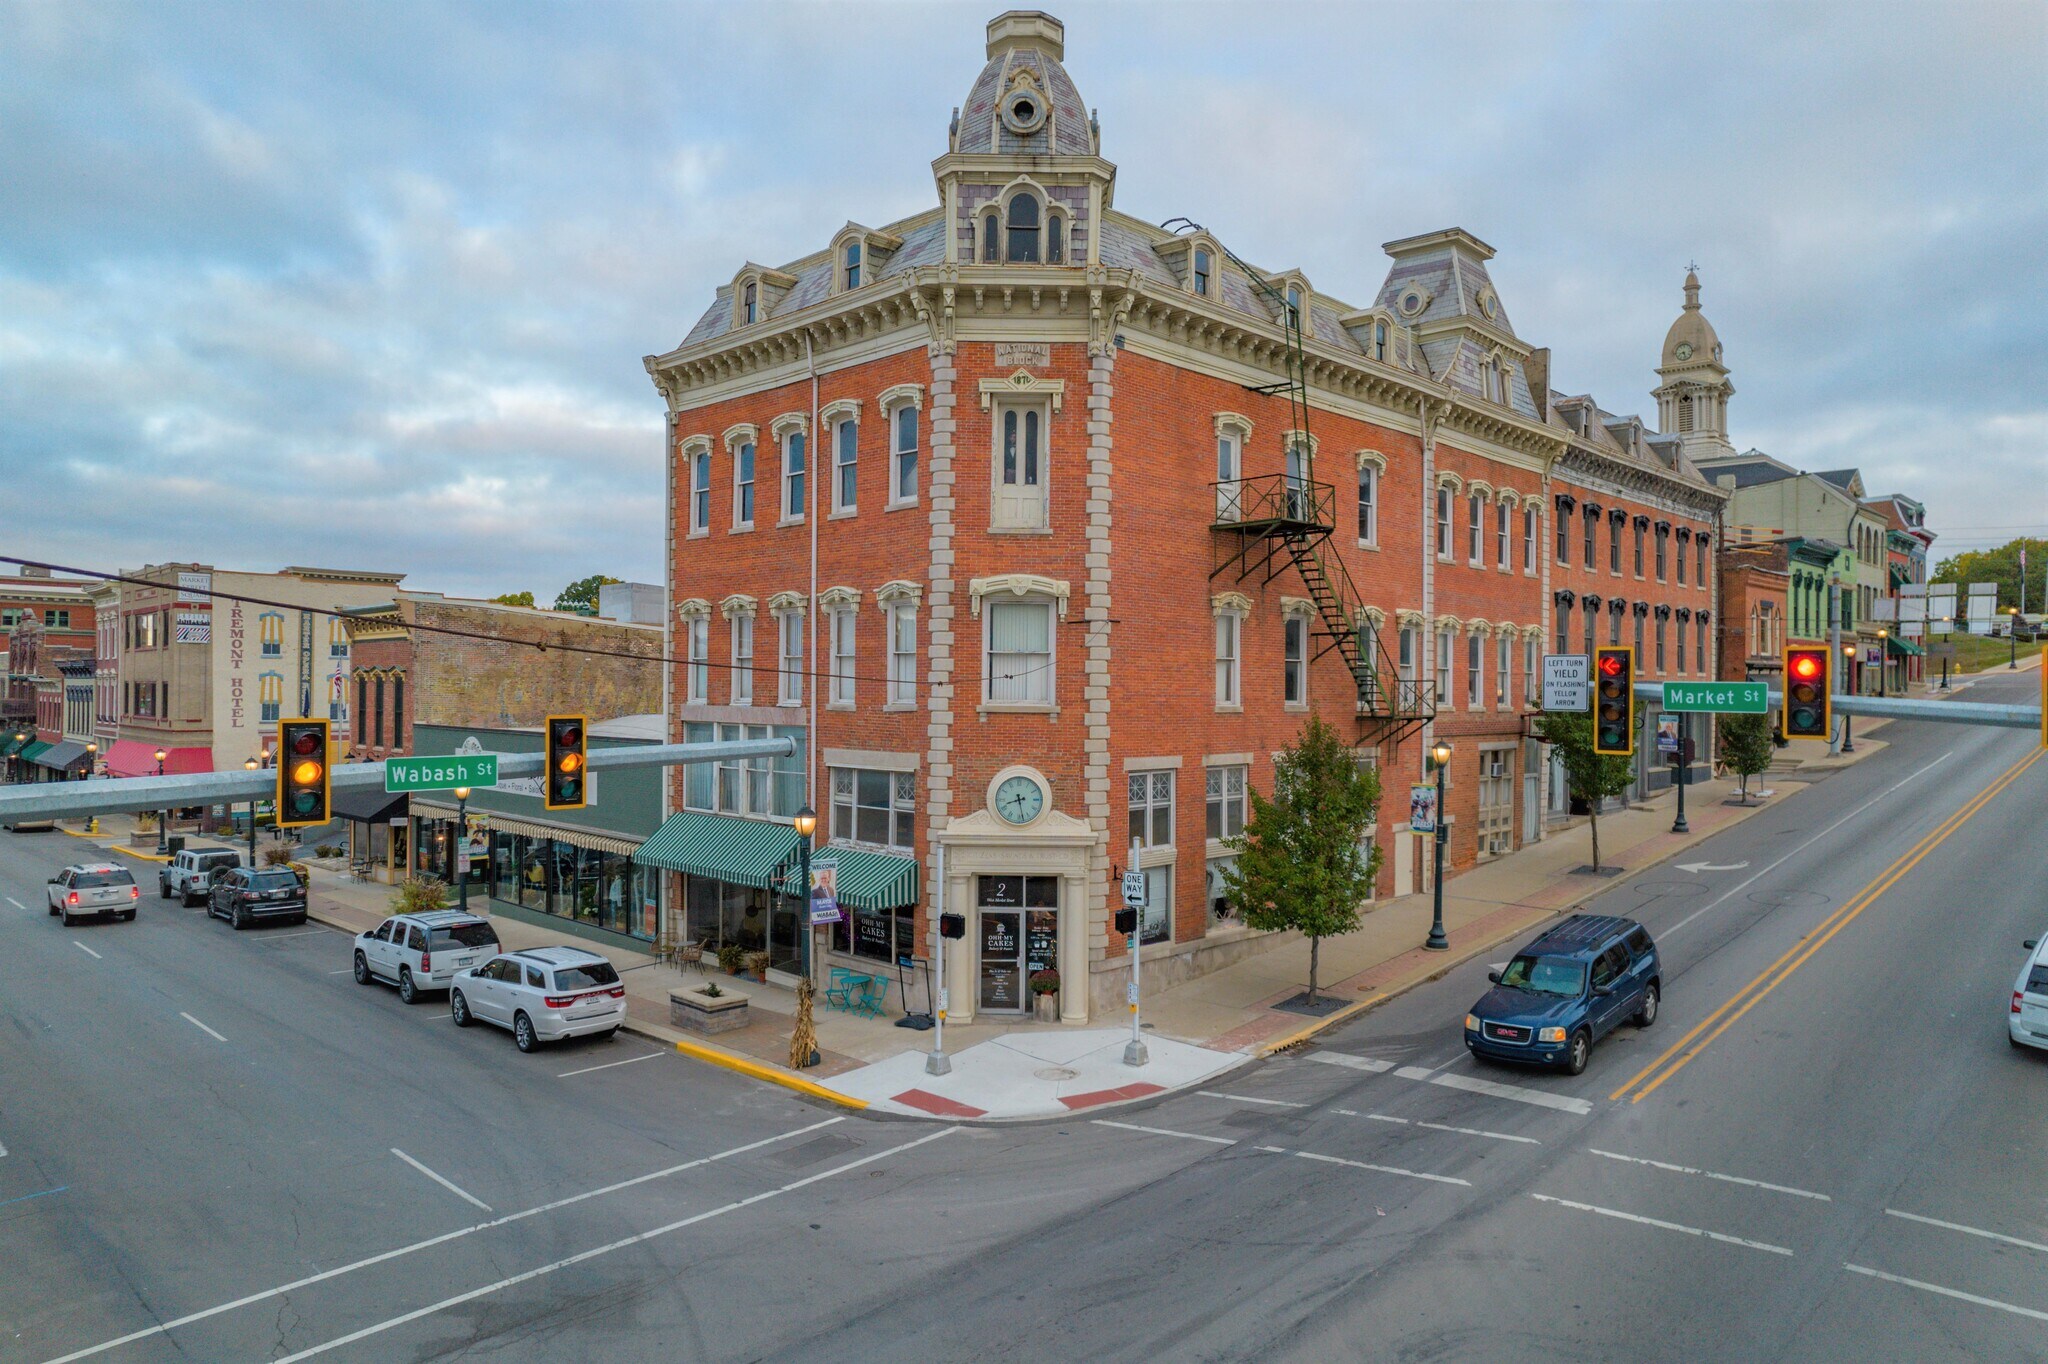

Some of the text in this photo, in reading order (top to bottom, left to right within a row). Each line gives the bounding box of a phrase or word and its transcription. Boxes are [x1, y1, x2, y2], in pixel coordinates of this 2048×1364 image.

[997, 345, 1046, 356] NATIONAL
[1007, 356, 1038, 365] BLOCK
[181, 576, 208, 584] MARKET
[230, 597, 245, 669] TREMONT
[1548, 659, 1584, 667] LEFT TURN
[1553, 669, 1578, 678] YIELD
[1670, 689, 1759, 705] Market St
[231, 678, 245, 728] HOTEL
[393, 762, 493, 783] Wabash St
[511, 782, 523, 791] Floral
[1126, 875, 1142, 884] ONE
[996, 883, 1006, 897] 2
[1126, 884, 1142, 893] WAY
[861, 926, 886, 938] CAKES
[1496, 1027, 1518, 1037] GMC
